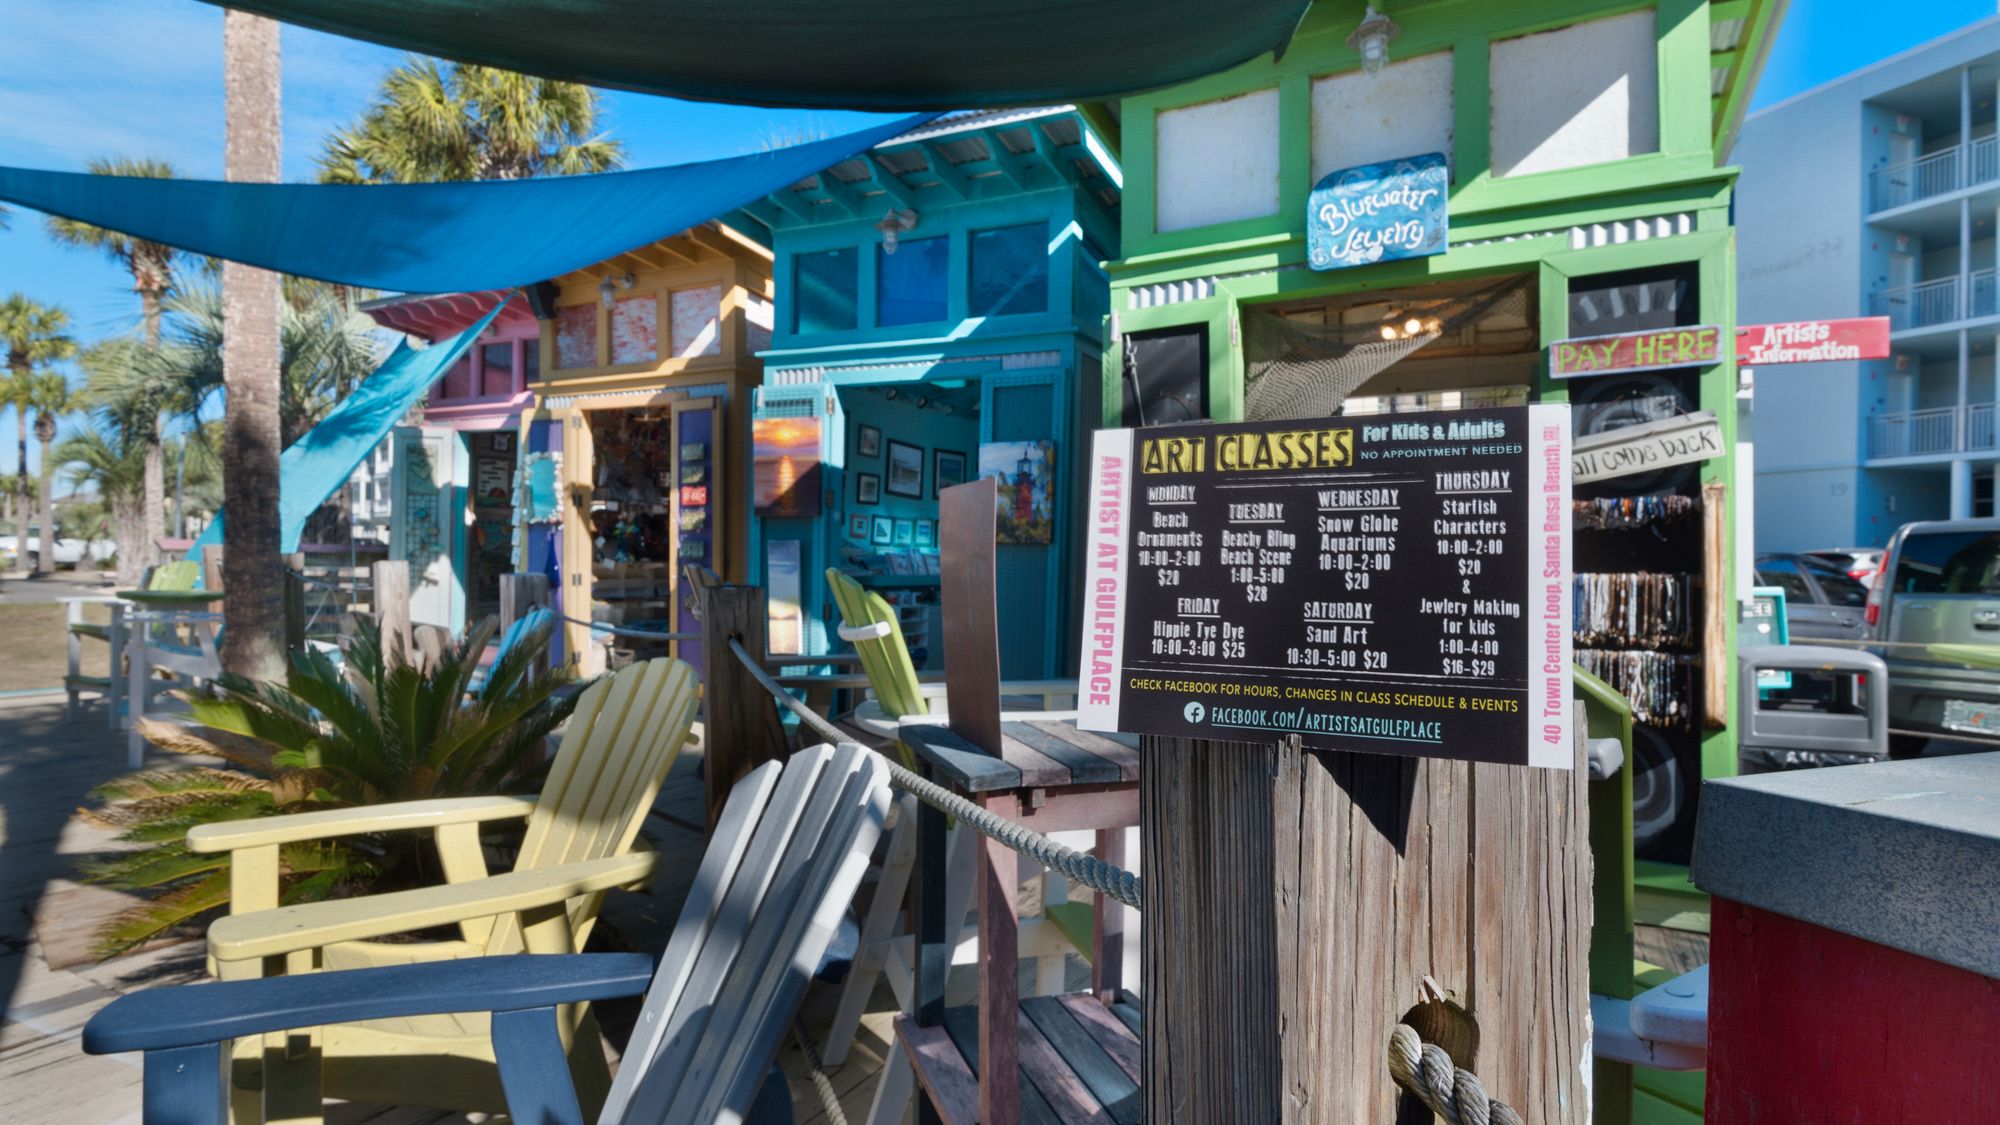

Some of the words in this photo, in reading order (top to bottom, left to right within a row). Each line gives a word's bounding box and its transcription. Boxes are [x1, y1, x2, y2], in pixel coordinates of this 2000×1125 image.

[1320, 185, 1438, 236] Bluewater
[1332, 220, 1424, 258] Jewelry
[1763, 324, 1830, 345] Artists
[1558, 339, 1621, 372] PAY
[1636, 330, 1718, 365] HERE
[1750, 342, 1860, 363] Information
[1363, 426, 1389, 442] For
[1392, 423, 1429, 440] Kids
[1433, 426, 1445, 439] &
[1448, 420, 1505, 439] Adults
[1143, 439, 1204, 472] ART
[1217, 430, 1351, 470] CLASSES
[1361, 451, 1378, 459] NO
[1383, 447, 1467, 458] APPOINTMENT
[1473, 444, 1522, 455] NEEDED
[1602, 445, 1657, 470] come
[1660, 431, 1716, 458] back
[1436, 472, 1510, 490] THURSDAY
[1098, 456, 1123, 537] ARTIST
[1148, 486, 1195, 501] MONDAY
[1318, 490, 1398, 507] WEDNESDAY
[1229, 504, 1283, 520] TUESDAY
[1443, 499, 1497, 515] Starfish
[1544, 494, 1560, 532] Rosa
[1153, 512, 1188, 528] Beach
[1318, 515, 1353, 532] Snow
[1361, 514, 1398, 532] Globe
[1434, 519, 1506, 535] Characters
[1138, 531, 1203, 547] Ornaments
[1222, 531, 1261, 548] Beachy
[1267, 529, 1296, 550] Bling
[1321, 535, 1395, 553] Aquariums
[1437, 539, 1503, 555] 10:00-2:00
[1097, 543, 1119, 571] AT
[1139, 551, 1200, 566] 10:00-2:00
[1221, 548, 1253, 565] Beach
[1260, 549, 1291, 565] Scene
[1319, 554, 1391, 570] 10:00-2:00
[1544, 534, 1560, 578] Santa
[1231, 568, 1284, 583] 1:00-5:00
[1459, 560, 1481, 576] $20
[1158, 570, 1179, 586] $20
[1345, 572, 1369, 591] $20
[1462, 580, 1470, 594] &
[1247, 585, 1267, 602] $28
[1544, 580, 1562, 619] Loop,
[1178, 598, 1219, 614] FRIDAY
[1304, 602, 1372, 619] SATURDAY
[1420, 599, 1467, 616] Jewlery
[1474, 601, 1519, 618] Making
[1154, 621, 1190, 639] Hippie
[1197, 622, 1216, 641] Tye
[1223, 623, 1244, 642] Dye
[1307, 626, 1336, 643] Sand
[1344, 627, 1368, 645] Art
[1443, 619, 1463, 634] for
[1469, 620, 1495, 635] kids
[1090, 578, 1117, 705] GULFPLACE
[1152, 639, 1215, 657] 10:00-3:00
[1223, 641, 1245, 659] $25
[1439, 639, 1498, 656] 1:00-4:00
[1544, 622, 1561, 674] Center
[1287, 648, 1356, 667] 10:30-5:00
[1364, 651, 1387, 669] $20
[1443, 660, 1495, 676] $16-$29
[1130, 679, 1162, 690] CHECK
[1165, 681, 1217, 694] FACEBOOK
[1221, 684, 1240, 695] FOR
[1244, 686, 1282, 698] HOURS,
[1286, 687, 1336, 701] CHANGES
[1341, 691, 1352, 702] IN
[1356, 692, 1391, 705] CLASS
[1395, 694, 1454, 708] SCHEDULE
[1459, 698, 1467, 709] &
[1472, 699, 1518, 712] EVENTS
[1544, 678, 1561, 717] Town
[1212, 706, 1441, 738] FACEBOOK.COM/ARTISTSATGULFPLACE
[1544, 725, 1561, 744] 40
